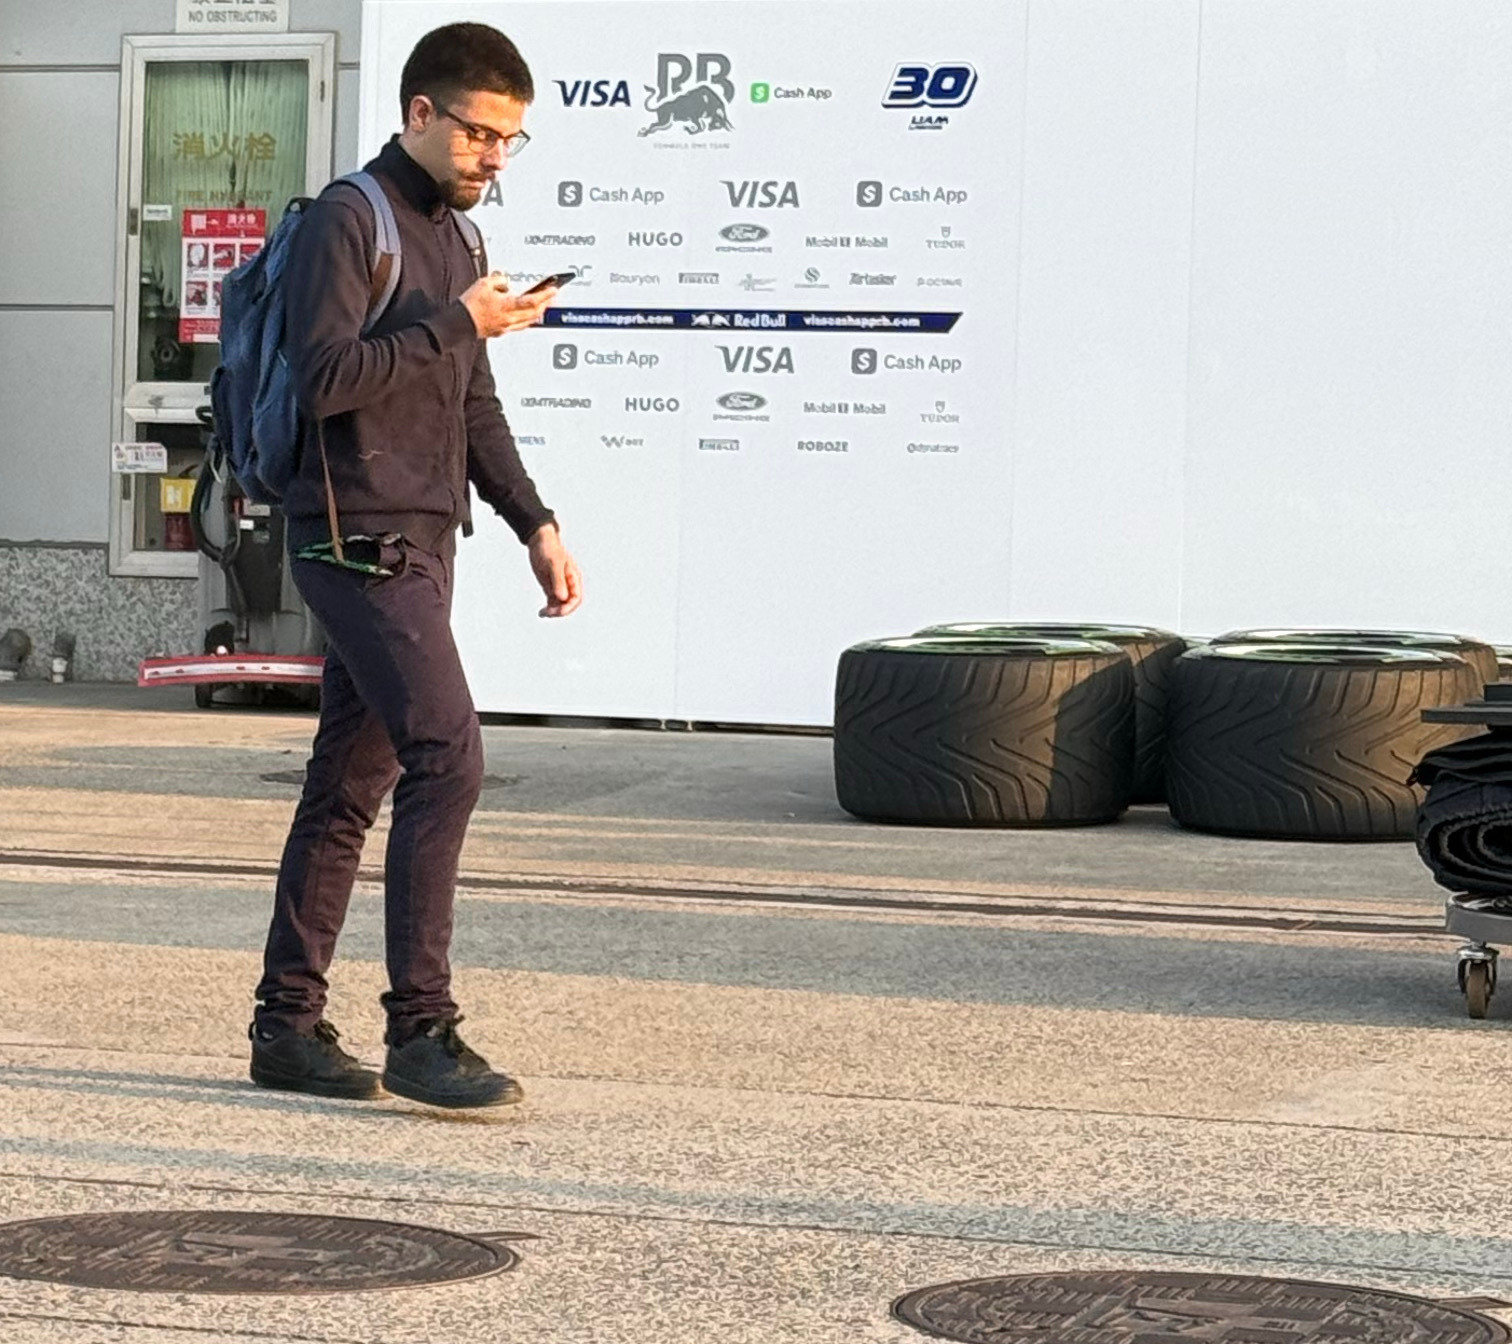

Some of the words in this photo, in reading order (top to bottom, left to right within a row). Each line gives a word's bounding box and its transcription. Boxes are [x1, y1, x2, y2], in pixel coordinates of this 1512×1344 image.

[188, 10, 204, 23] NO
[207, 10, 278, 23] OBSTRUCTING
[551, 79, 632, 108] VISA
[774, 86, 804, 100] Cash
[807, 87, 833, 100] App
[887, 66, 972, 101] 30
[172, 131, 277, 161] 消火栓
[589, 187, 629, 203] Cash
[631, 187, 665, 205] App
[719, 179, 800, 208] VISA
[889, 186, 931, 203] Cash
[933, 186, 968, 205] App
[628, 231, 684, 247] HUGO
[805, 236, 838, 248] Mobil
[855, 236, 888, 248] Mobil
[733, 313, 760, 327] Red
[761, 313, 787, 327] Bull
[584, 350, 623, 365] Cash
[626, 350, 659, 369] App
[714, 344, 795, 374] VISA
[884, 354, 925, 370] Cash
[928, 354, 962, 373] App
[625, 397, 680, 412] HUGO
[803, 401, 836, 414] Mobil
[853, 402, 886, 414] Mobil
